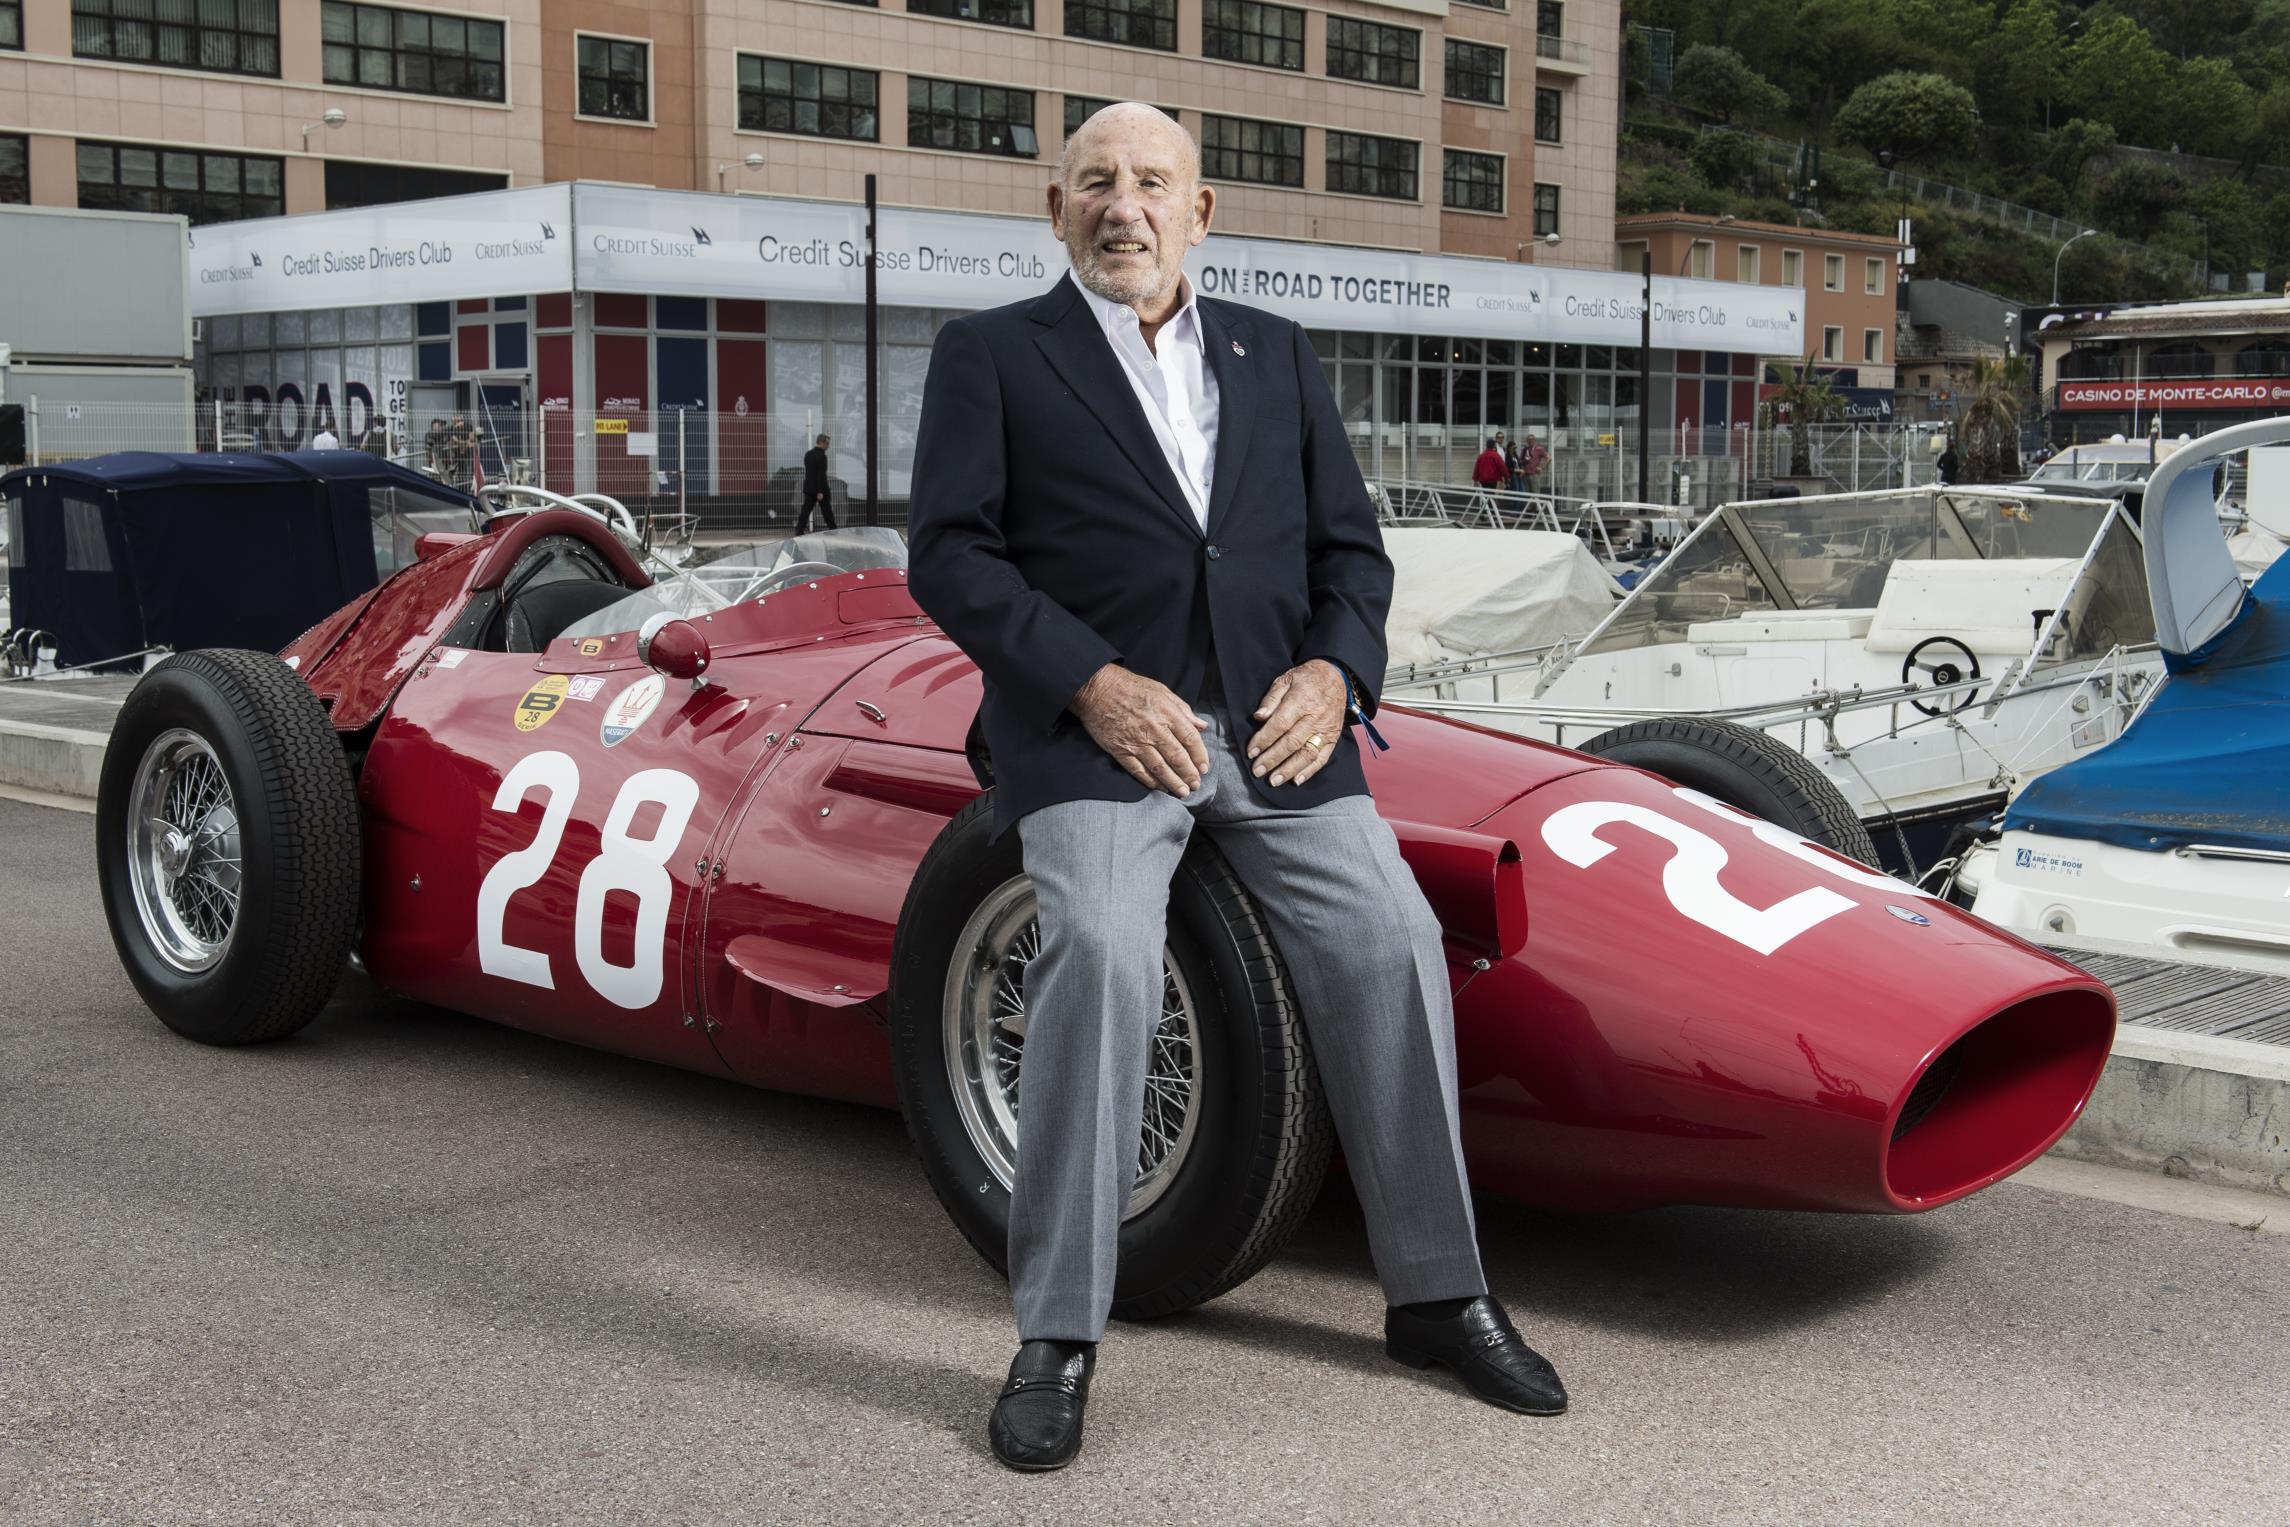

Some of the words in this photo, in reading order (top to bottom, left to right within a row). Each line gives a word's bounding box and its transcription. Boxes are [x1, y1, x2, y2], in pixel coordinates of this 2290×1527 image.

[475, 242, 511, 260] CREDIT
[512, 239, 544, 257] SUISSE
[594, 234, 648, 255] CREDIT
[650, 238, 697, 258] SUISSE
[759, 235, 830, 266] Credit
[839, 240, 911, 270] Susse
[919, 246, 991, 275] Drivers
[998, 251, 1045, 279] Club
[283, 252, 320, 277] Credit
[324, 250, 366, 273] Suisse
[369, 247, 415, 269] Drivers
[419, 241, 452, 265] Club
[1201, 265, 1237, 294] ON
[1242, 269, 1250, 295] THE
[1254, 269, 1323, 299] ROAD
[1330, 275, 1451, 308] TOGETHER
[1565, 295, 1606, 318] Credit
[1609, 299, 1644, 320] Suiss
[1654, 302, 1695, 324] Drivers
[1699, 305, 1726, 326] Club
[2064, 389, 2122, 403] CASINO
[2124, 388, 2146, 401] DE
[2149, 386, 2267, 401] MONTE-CARLO
[243, 381, 375, 451] ROAD
[583, 644, 599, 654] B
[520, 692, 560, 712] B
[524, 711, 540, 724] 28
[2050, 858, 2060, 866] DE
[2062, 860, 2083, 869] BOOM
[477, 749, 701, 1010] 28
